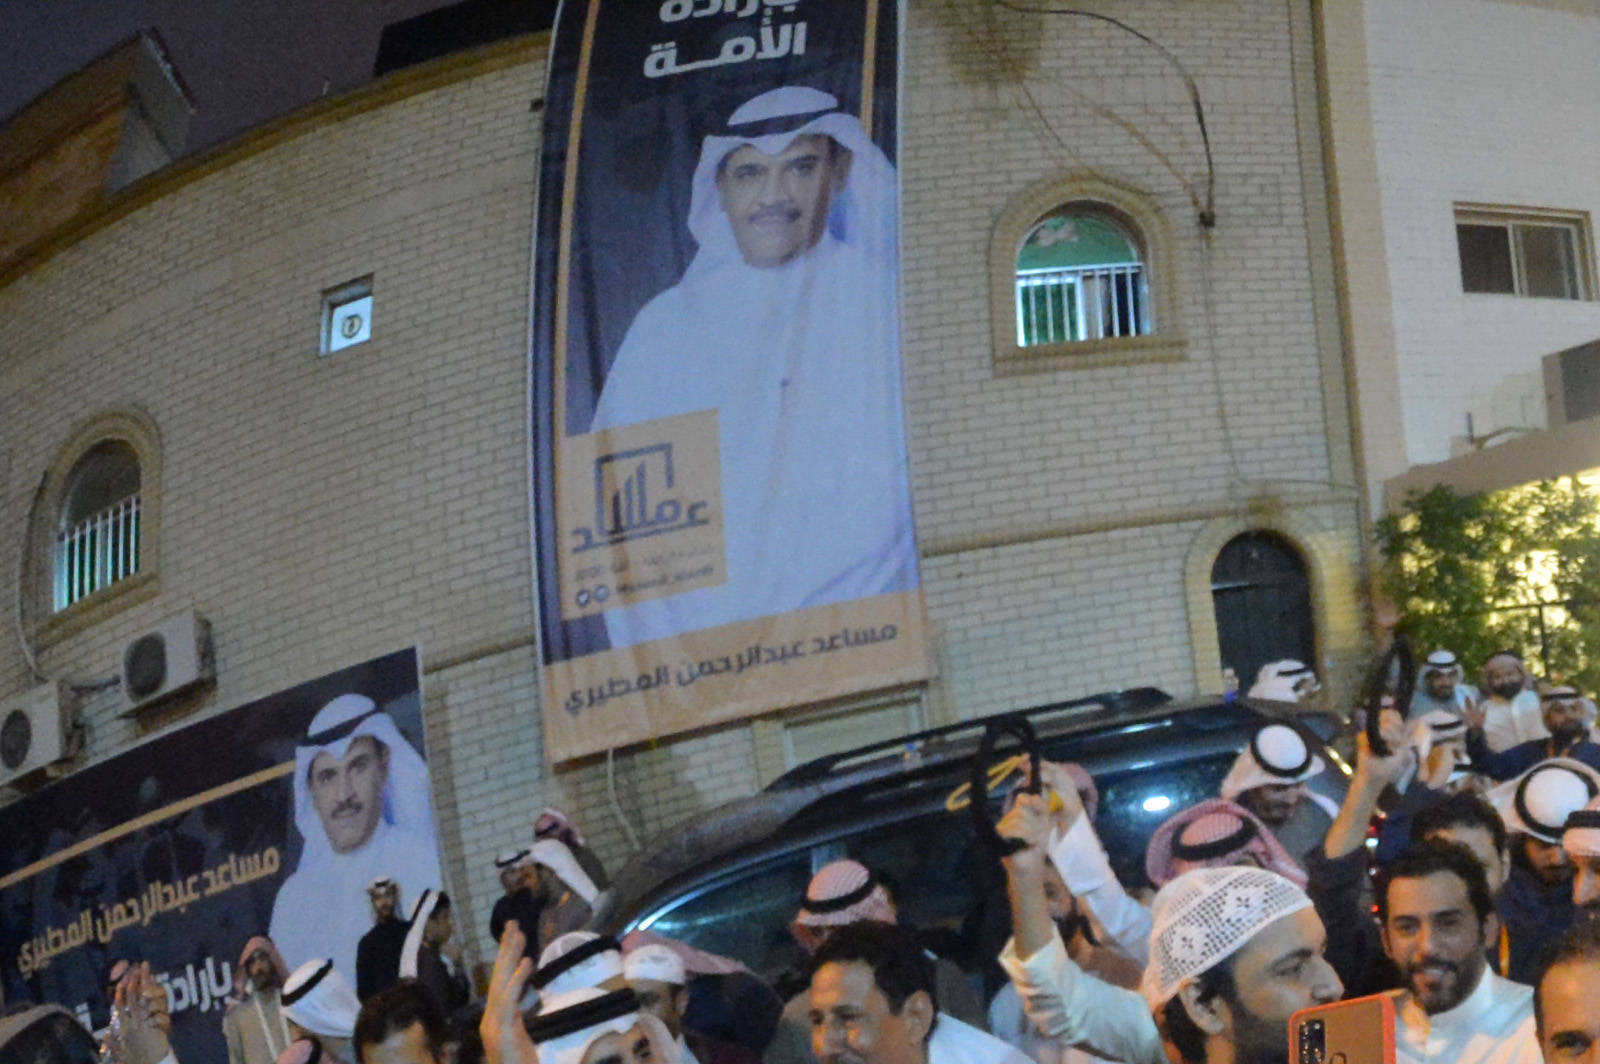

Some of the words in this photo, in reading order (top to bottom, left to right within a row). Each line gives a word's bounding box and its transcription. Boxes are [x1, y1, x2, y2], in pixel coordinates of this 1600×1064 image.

[643, 17, 808, 78] الأمة
[676, 641, 807, 687] عبدالرحمن
[811, 624, 898, 655] مساعد
[564, 666, 670, 716] المطيري
[204, 847, 280, 897] مساعد
[97, 874, 201, 944] عبدالرحمن
[17, 908, 94, 981] المطيري
